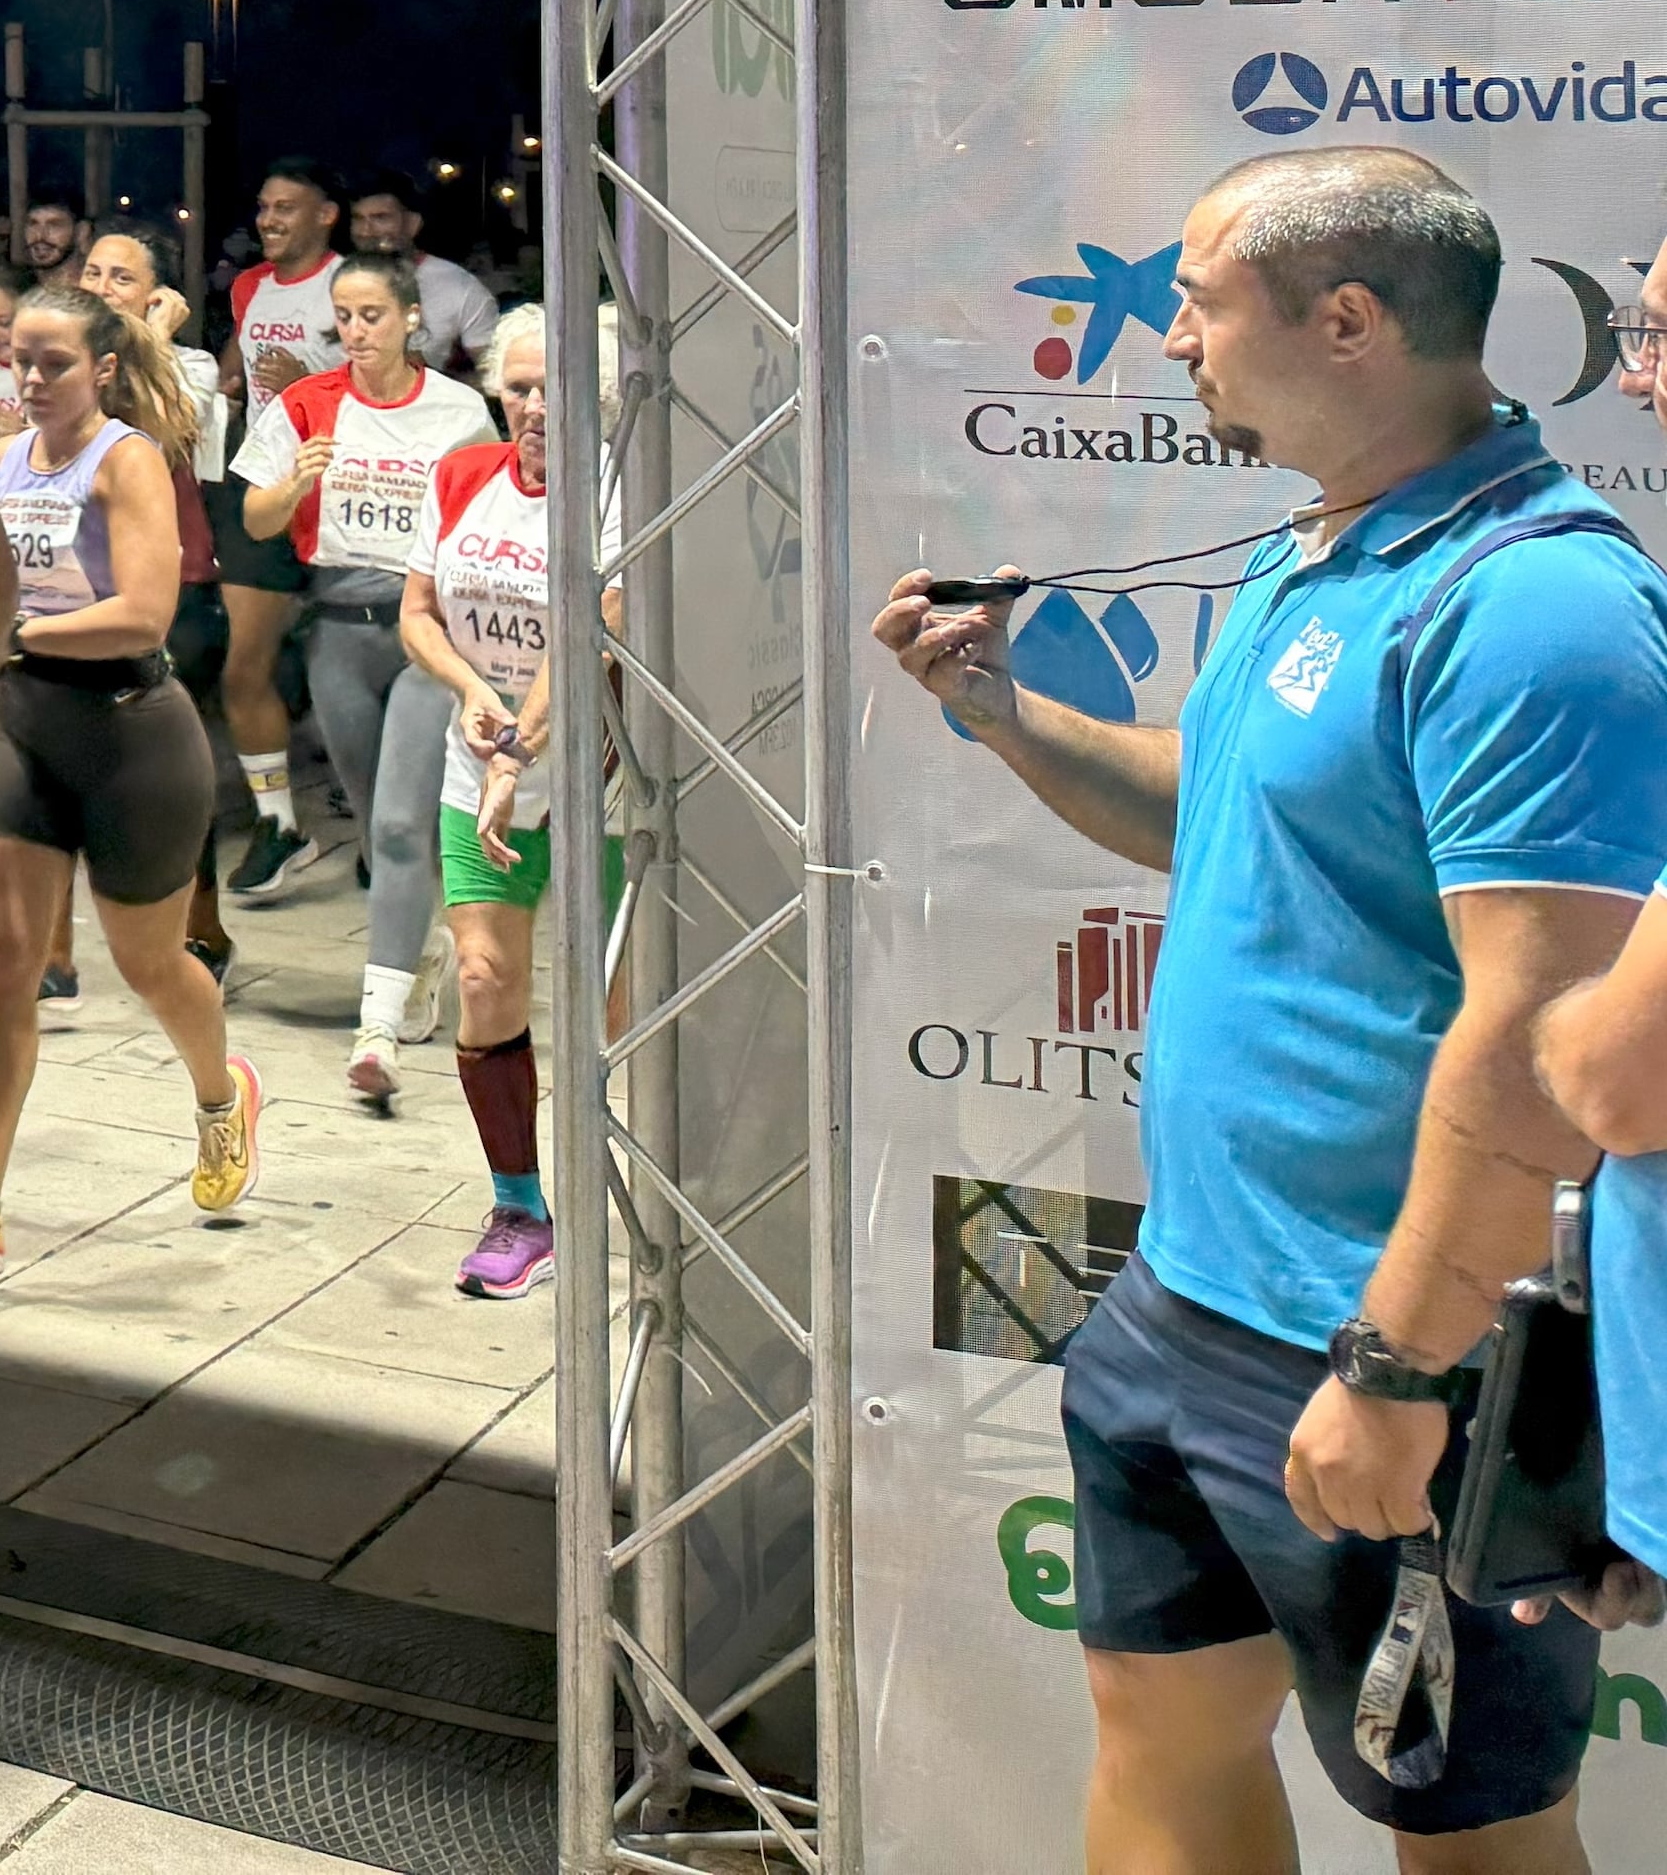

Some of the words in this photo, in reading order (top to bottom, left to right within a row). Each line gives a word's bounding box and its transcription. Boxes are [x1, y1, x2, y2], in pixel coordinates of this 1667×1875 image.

[249, 322, 306, 342] CURSA
[340, 498, 414, 534] 1618
[465, 607, 546, 651] 1443
